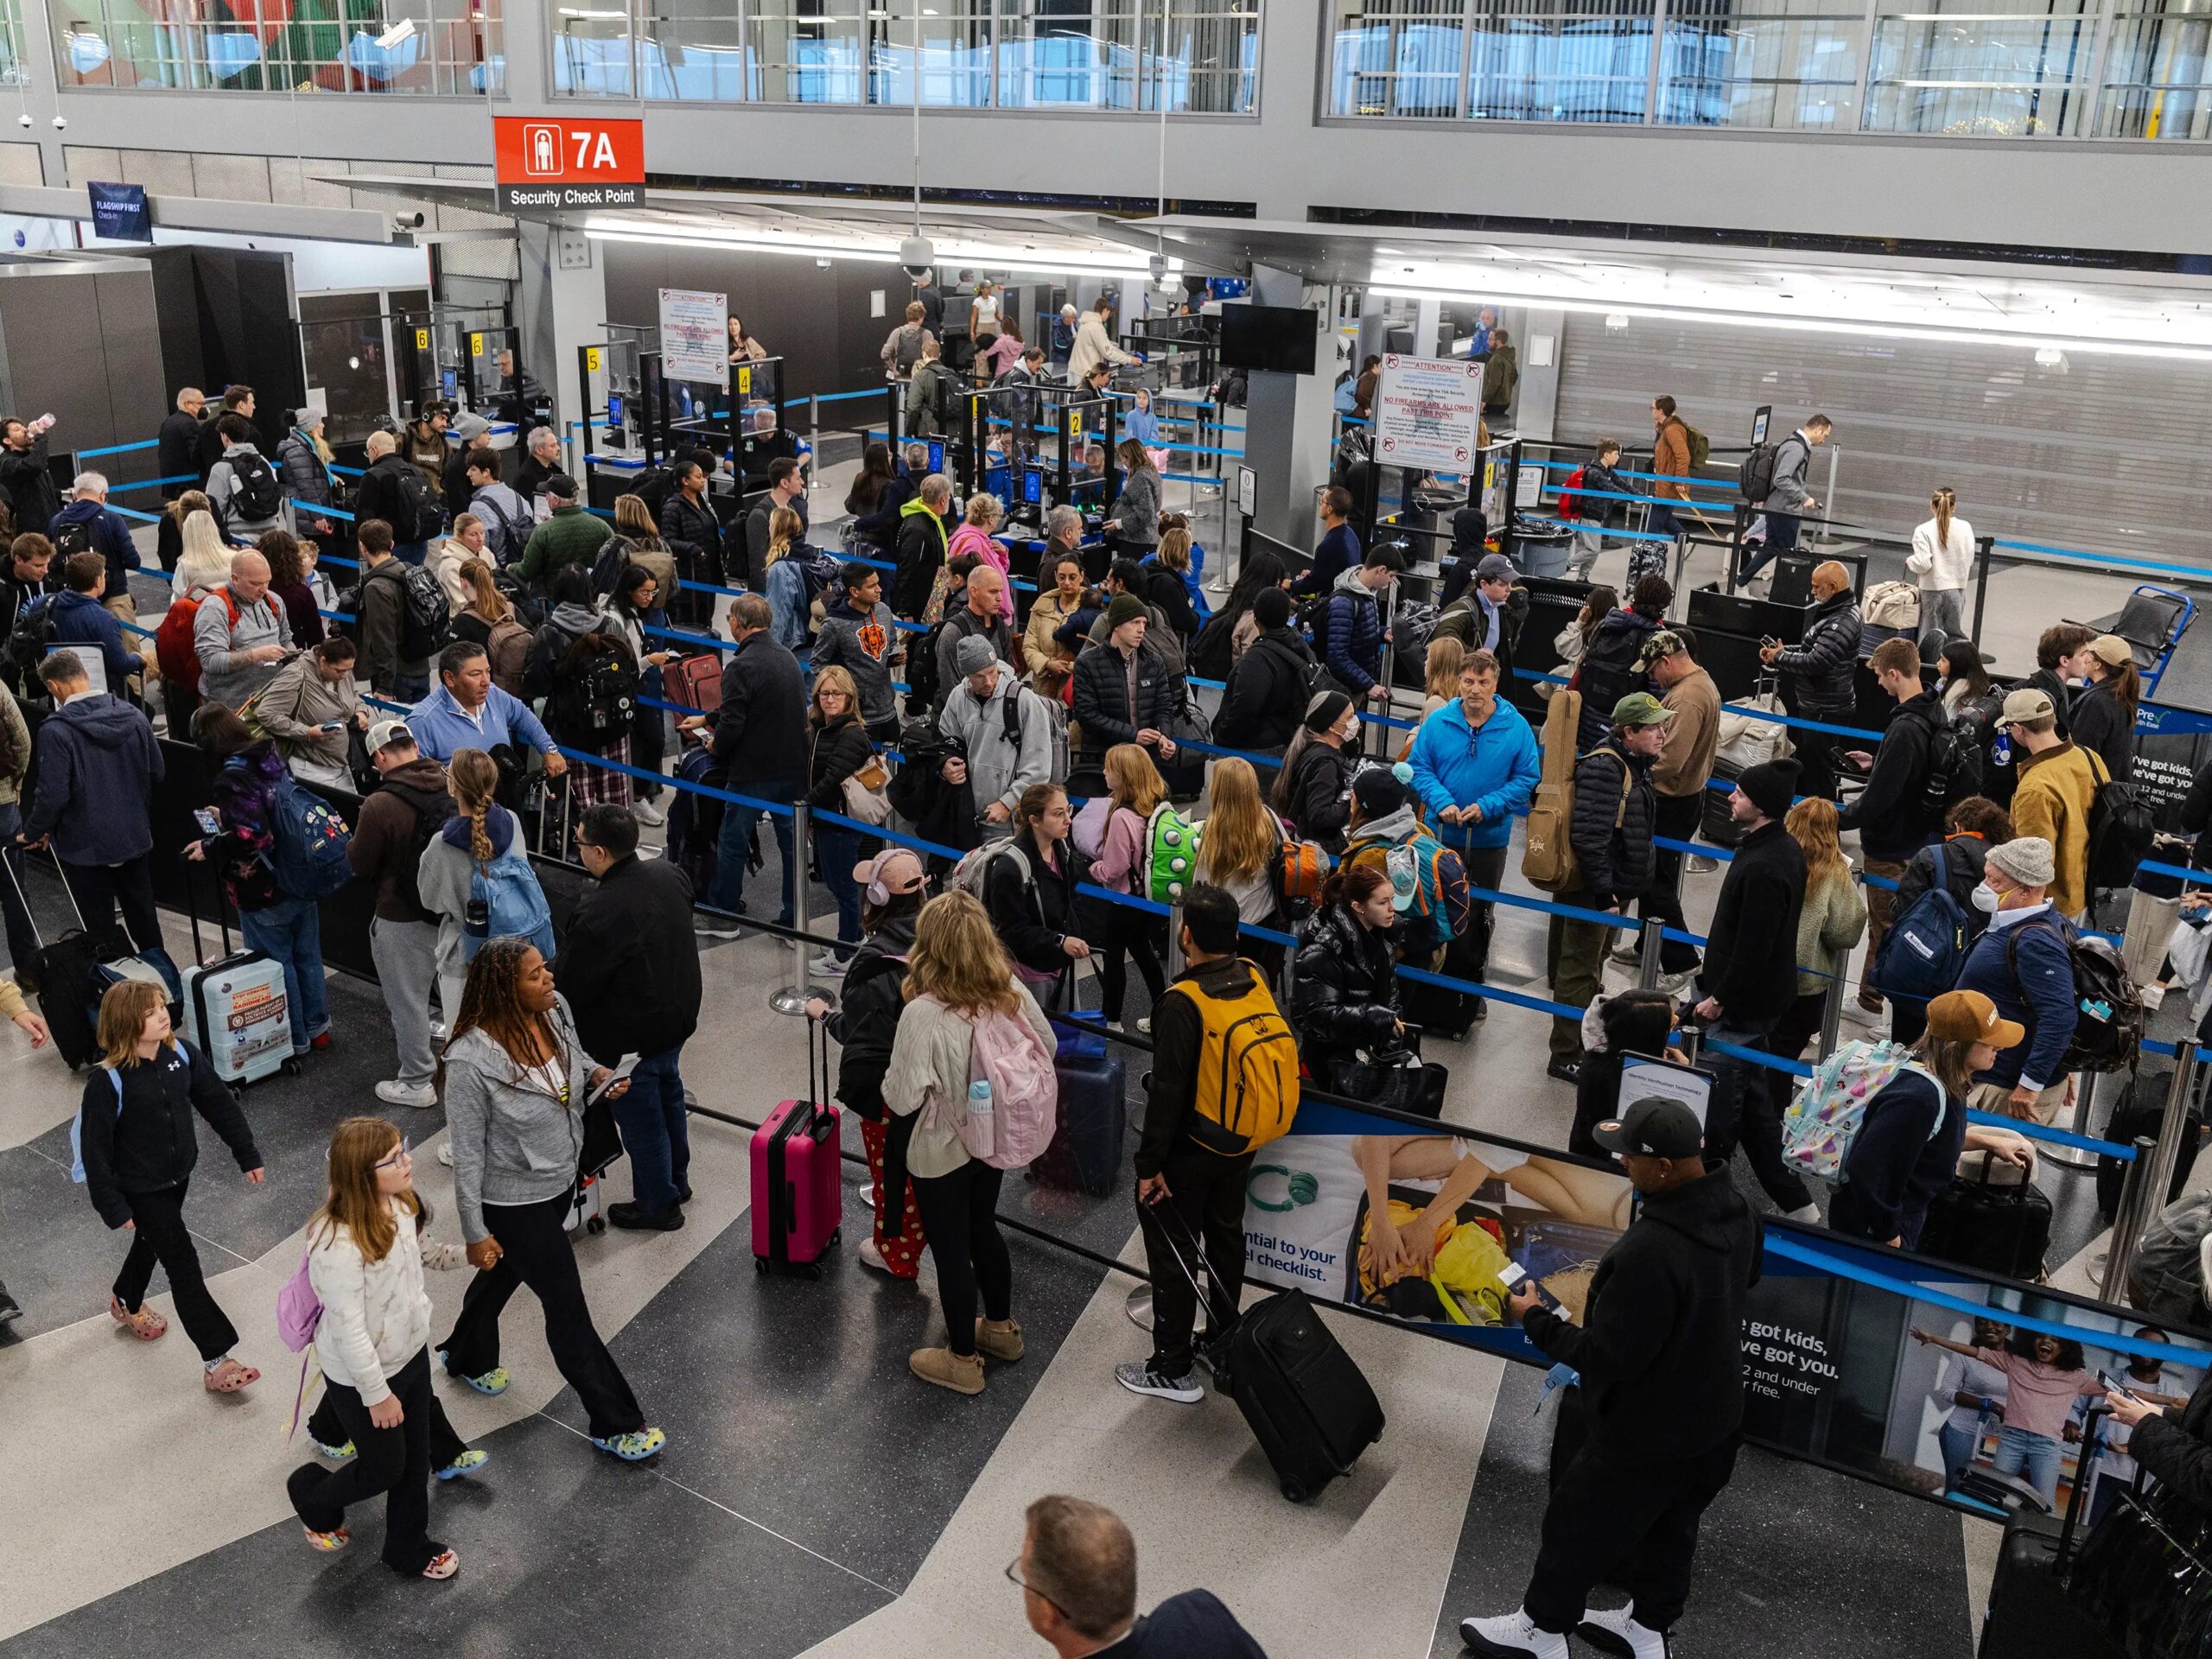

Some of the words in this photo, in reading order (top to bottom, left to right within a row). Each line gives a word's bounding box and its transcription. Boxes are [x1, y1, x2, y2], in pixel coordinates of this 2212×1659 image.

[571, 131, 618, 169] 7A
[511, 189, 561, 207] Security
[564, 189, 602, 204] Check
[606, 188, 635, 203] Point
[96, 200, 124, 211] FLAGSHIP
[124, 203, 140, 213] FIRST
[418, 332, 426, 346] 6
[473, 340, 481, 354] 6
[589, 354, 598, 370] 5
[1415, 362, 1452, 371] ATTENTION
[741, 375, 748, 391] 4
[1395, 397, 1426, 407] FIREARMS
[1443, 403, 1474, 412] ALLOWED
[1434, 410, 1454, 419] POINT
[1072, 416, 1078, 433] 2
[1488, 467, 1492, 483] 1
[2136, 709, 2154, 721] Pre
[2146, 720, 2159, 729] Ease
[2151, 760, 2169, 771] got
[2169, 763, 2193, 778] kids,
[2157, 774, 2176, 785] got
[2141, 785, 2151, 793] 12
[2150, 795, 2166, 804] free.
[233, 995, 271, 1009] RADIOHEAD!
[245, 1008, 259, 1017] PROUD
[260, 1002, 274, 1012] PARENT
[266, 1002, 283, 1014] ACADEMY
[245, 1016, 260, 1025] HONOR
[1628, 1072, 1646, 1082] Identity
[1648, 1077, 1674, 1088] Verification
[1675, 1084, 1701, 1096] Technology
[1280, 1240, 1296, 1255] to
[1300, 1247, 1337, 1264] your
[1257, 1253, 1326, 1282] checklist.
[1749, 1321, 1781, 1340] got
[1784, 1328, 1827, 1357] kids,
[1764, 1347, 1796, 1366] got
[1799, 1357, 1839, 1379] you.
[1754, 1370, 1779, 1383] and
[1782, 1376, 1821, 1395] under
[1752, 1382, 1780, 1399] free.
